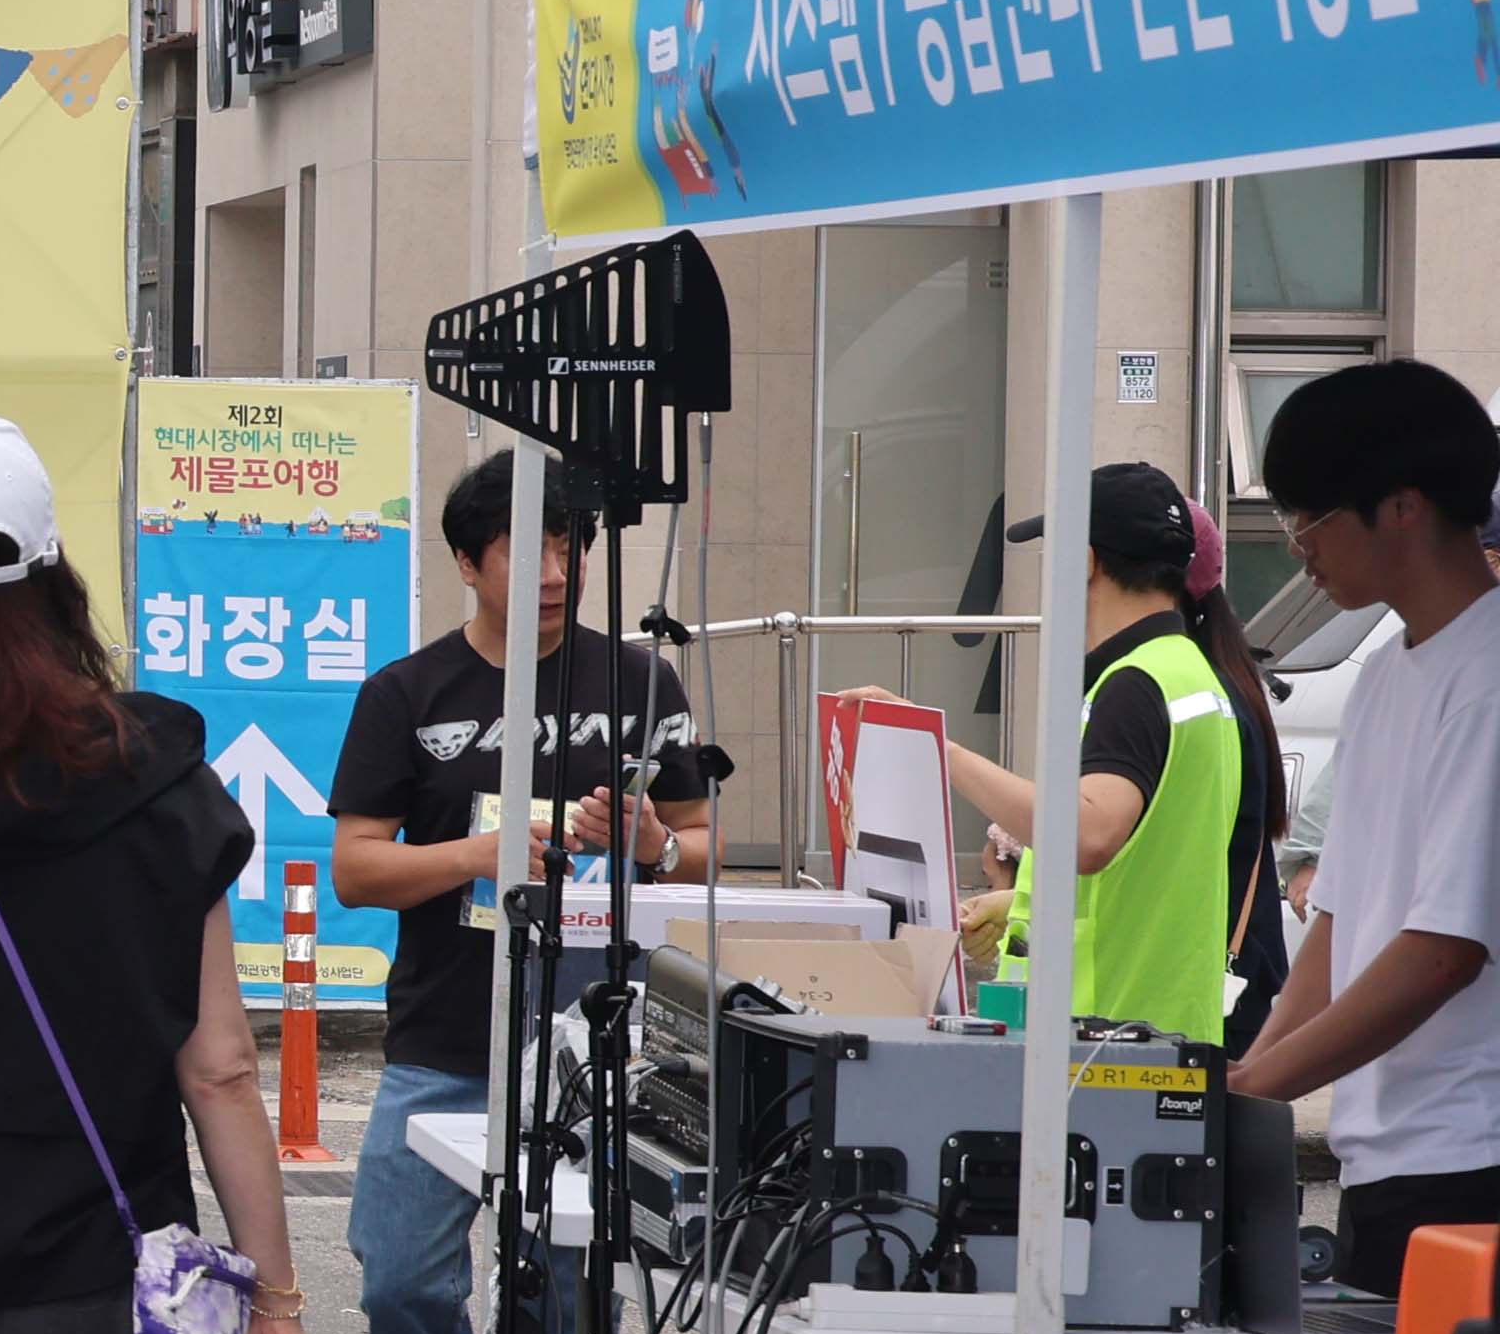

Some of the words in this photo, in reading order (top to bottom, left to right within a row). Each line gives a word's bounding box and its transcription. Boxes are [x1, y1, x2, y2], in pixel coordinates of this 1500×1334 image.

[573, 359, 657, 372] SENNHEISER
[1125, 377, 1150, 387] 8572
[227, 403, 284, 429] 제2회
[154, 426, 283, 454] 현대시장에서
[292, 430, 358, 456] 떠나는
[170, 455, 340, 497] 제물포여행
[143, 592, 368, 682] 화장실
[559, 910, 613, 928] efal
[1103, 1068, 1126, 1083] R1
[1140, 1070, 1173, 1085] 4ch
[1183, 1072, 1196, 1086] A
